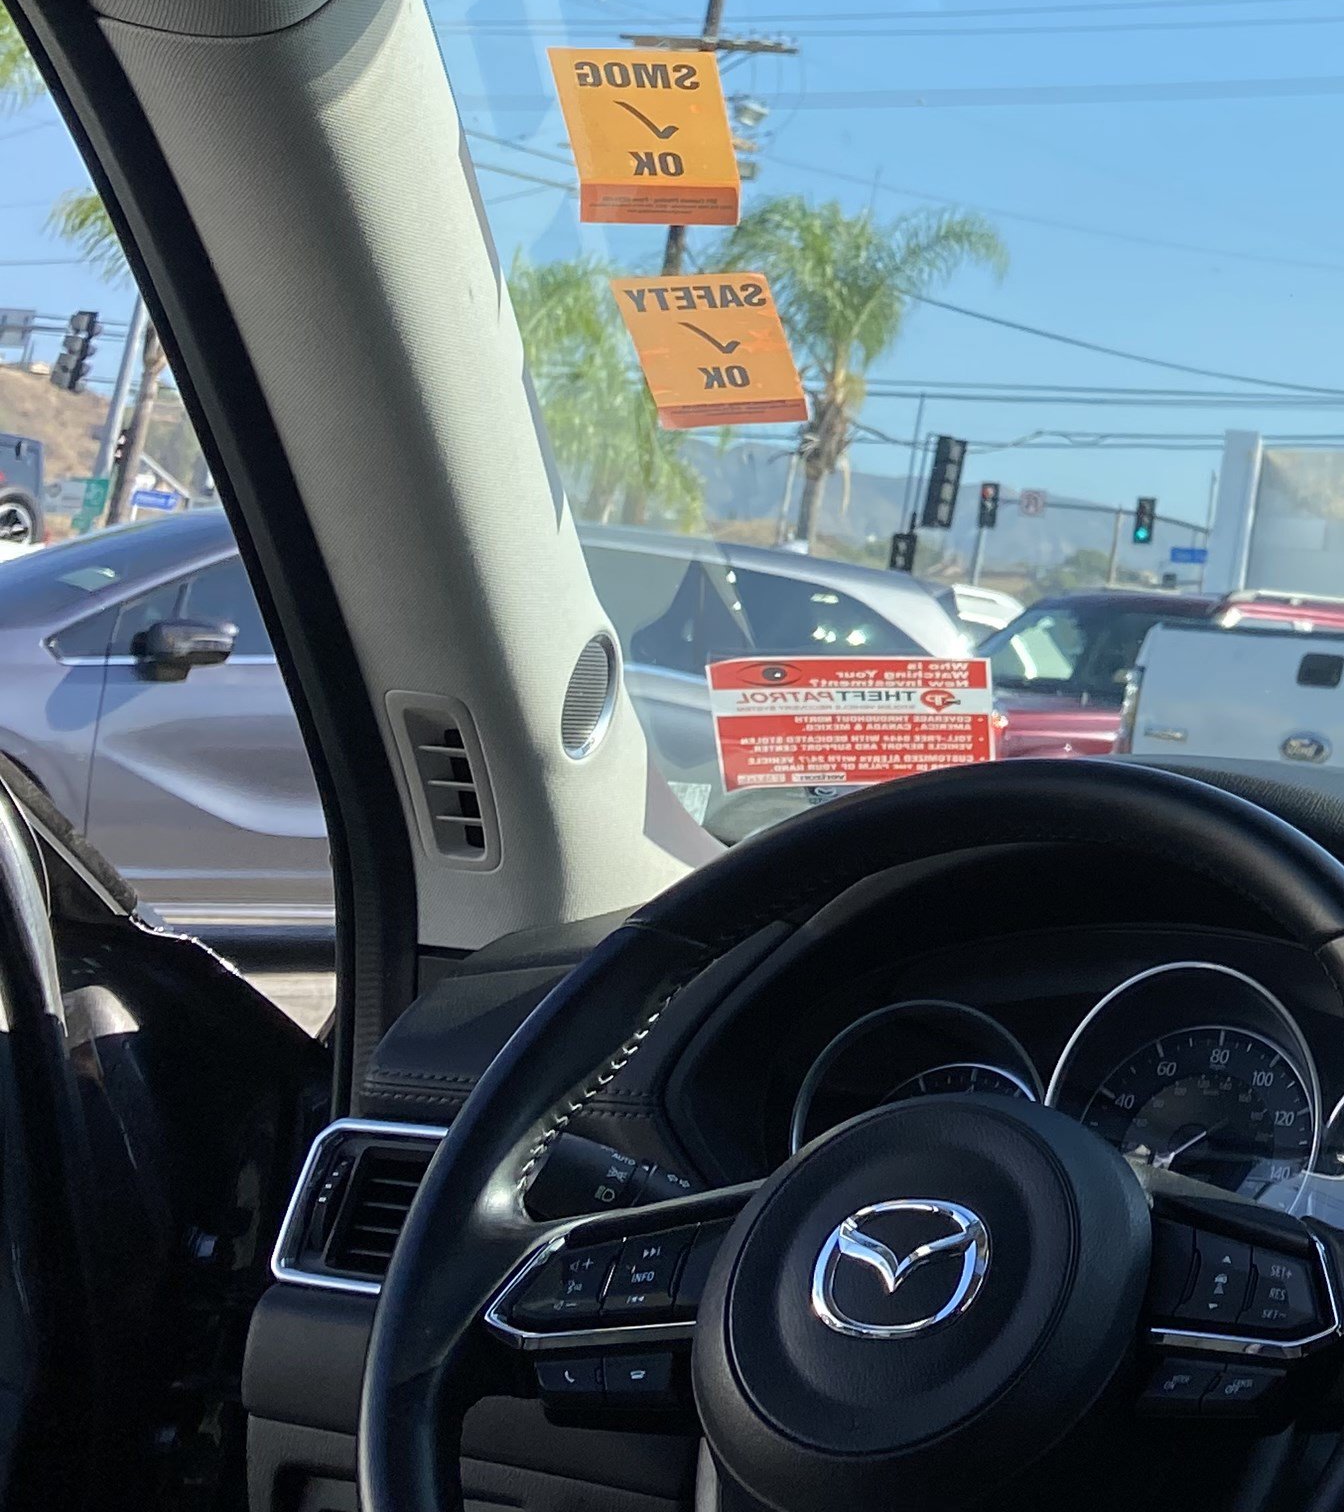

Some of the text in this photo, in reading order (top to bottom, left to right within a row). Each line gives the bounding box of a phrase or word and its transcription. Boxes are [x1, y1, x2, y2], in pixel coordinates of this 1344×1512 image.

[1210, 1050, 1230, 1064] 80
[1157, 1061, 1177, 1076] 60
[1252, 1071, 1274, 1087] 100
[1115, 1094, 1135, 1109] 40
[1273, 1111, 1295, 1127] 120
[612, 1152, 636, 1166] AUTO
[1270, 1166, 1291, 1179] 140
[631, 1270, 655, 1283] INFO
[1268, 1287, 1286, 1300] RES
